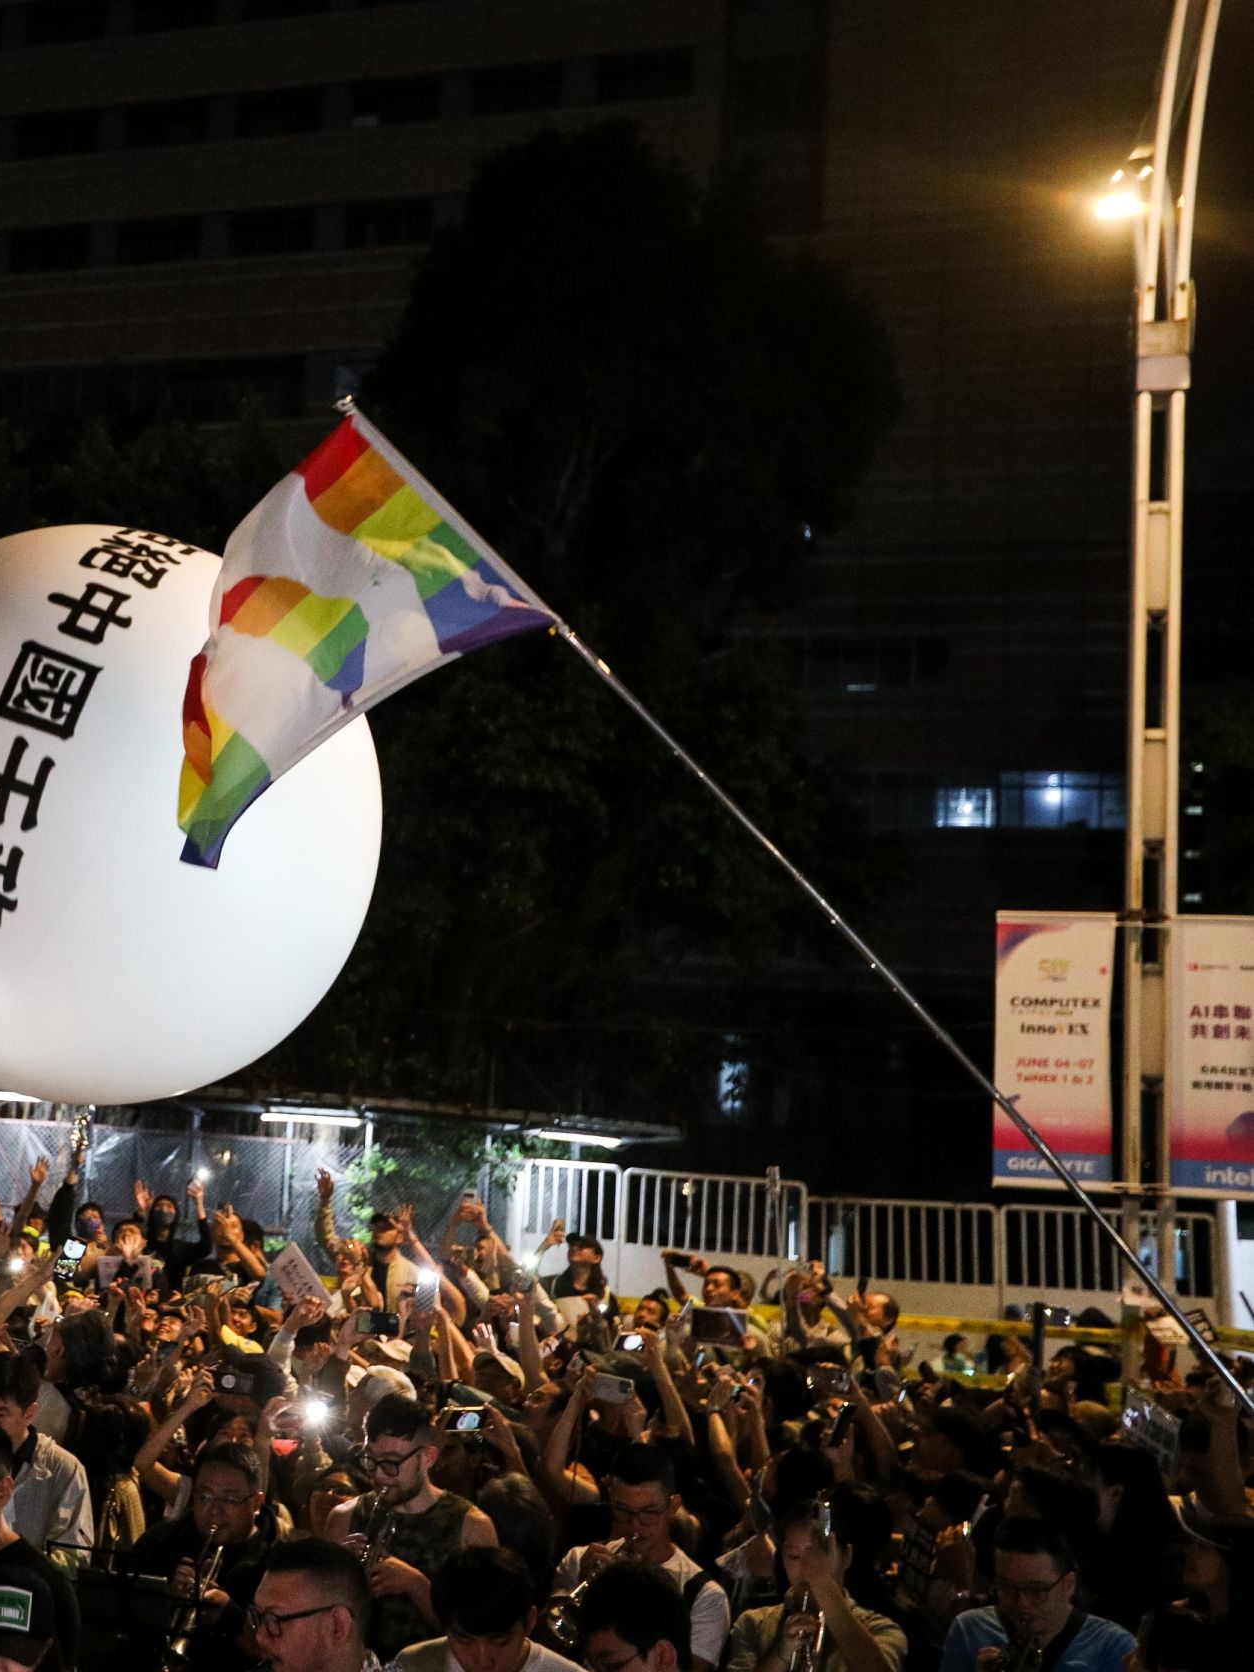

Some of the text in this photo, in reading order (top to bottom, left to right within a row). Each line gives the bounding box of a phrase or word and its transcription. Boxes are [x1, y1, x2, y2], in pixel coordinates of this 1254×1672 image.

[1009, 995, 1101, 1009] COMPUTEX
[1016, 1057, 1049, 1068] JUNE
[1007, 1156, 1095, 1175] GIGAYTE
